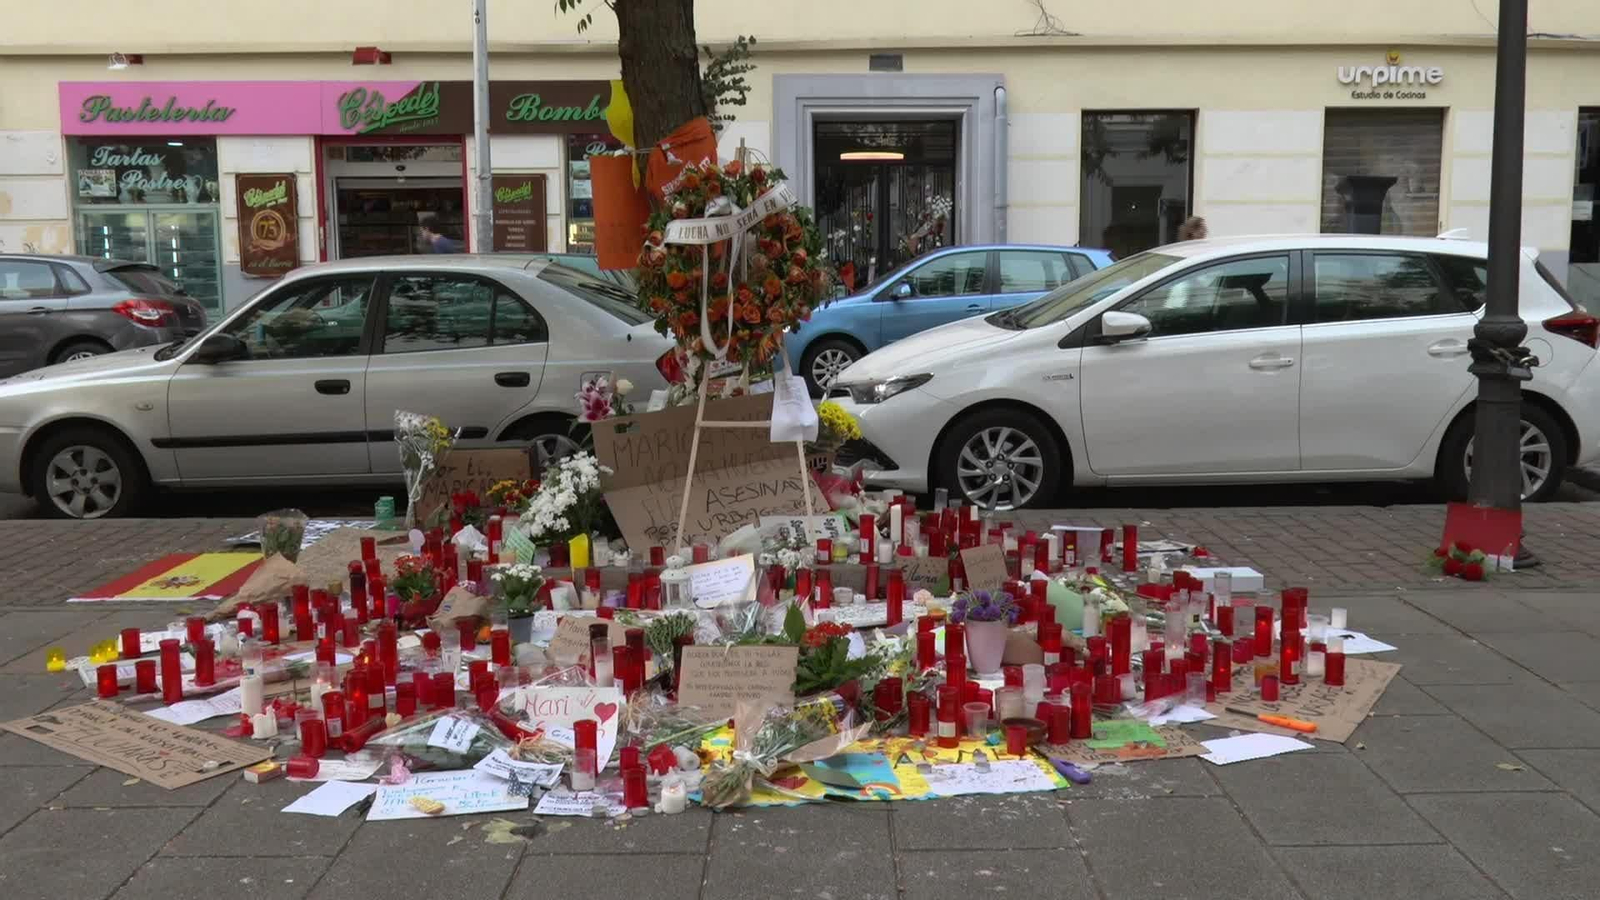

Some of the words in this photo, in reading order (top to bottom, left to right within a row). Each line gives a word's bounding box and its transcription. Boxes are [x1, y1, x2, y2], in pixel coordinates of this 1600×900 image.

[1337, 65, 1444, 87] urpime
[1351, 90, 1381, 100] Estudio
[1383, 90, 1394, 100] de
[1396, 90, 1426, 100] Cocinas
[80, 95, 236, 123] Pastelería
[92, 146, 165, 167] Tartas
[260, 220, 278, 239] 75
[679, 226, 709, 240] LUCHA
[715, 222, 730, 236] NO
[764, 198, 777, 212] EN
[524, 694, 569, 718] Mari
